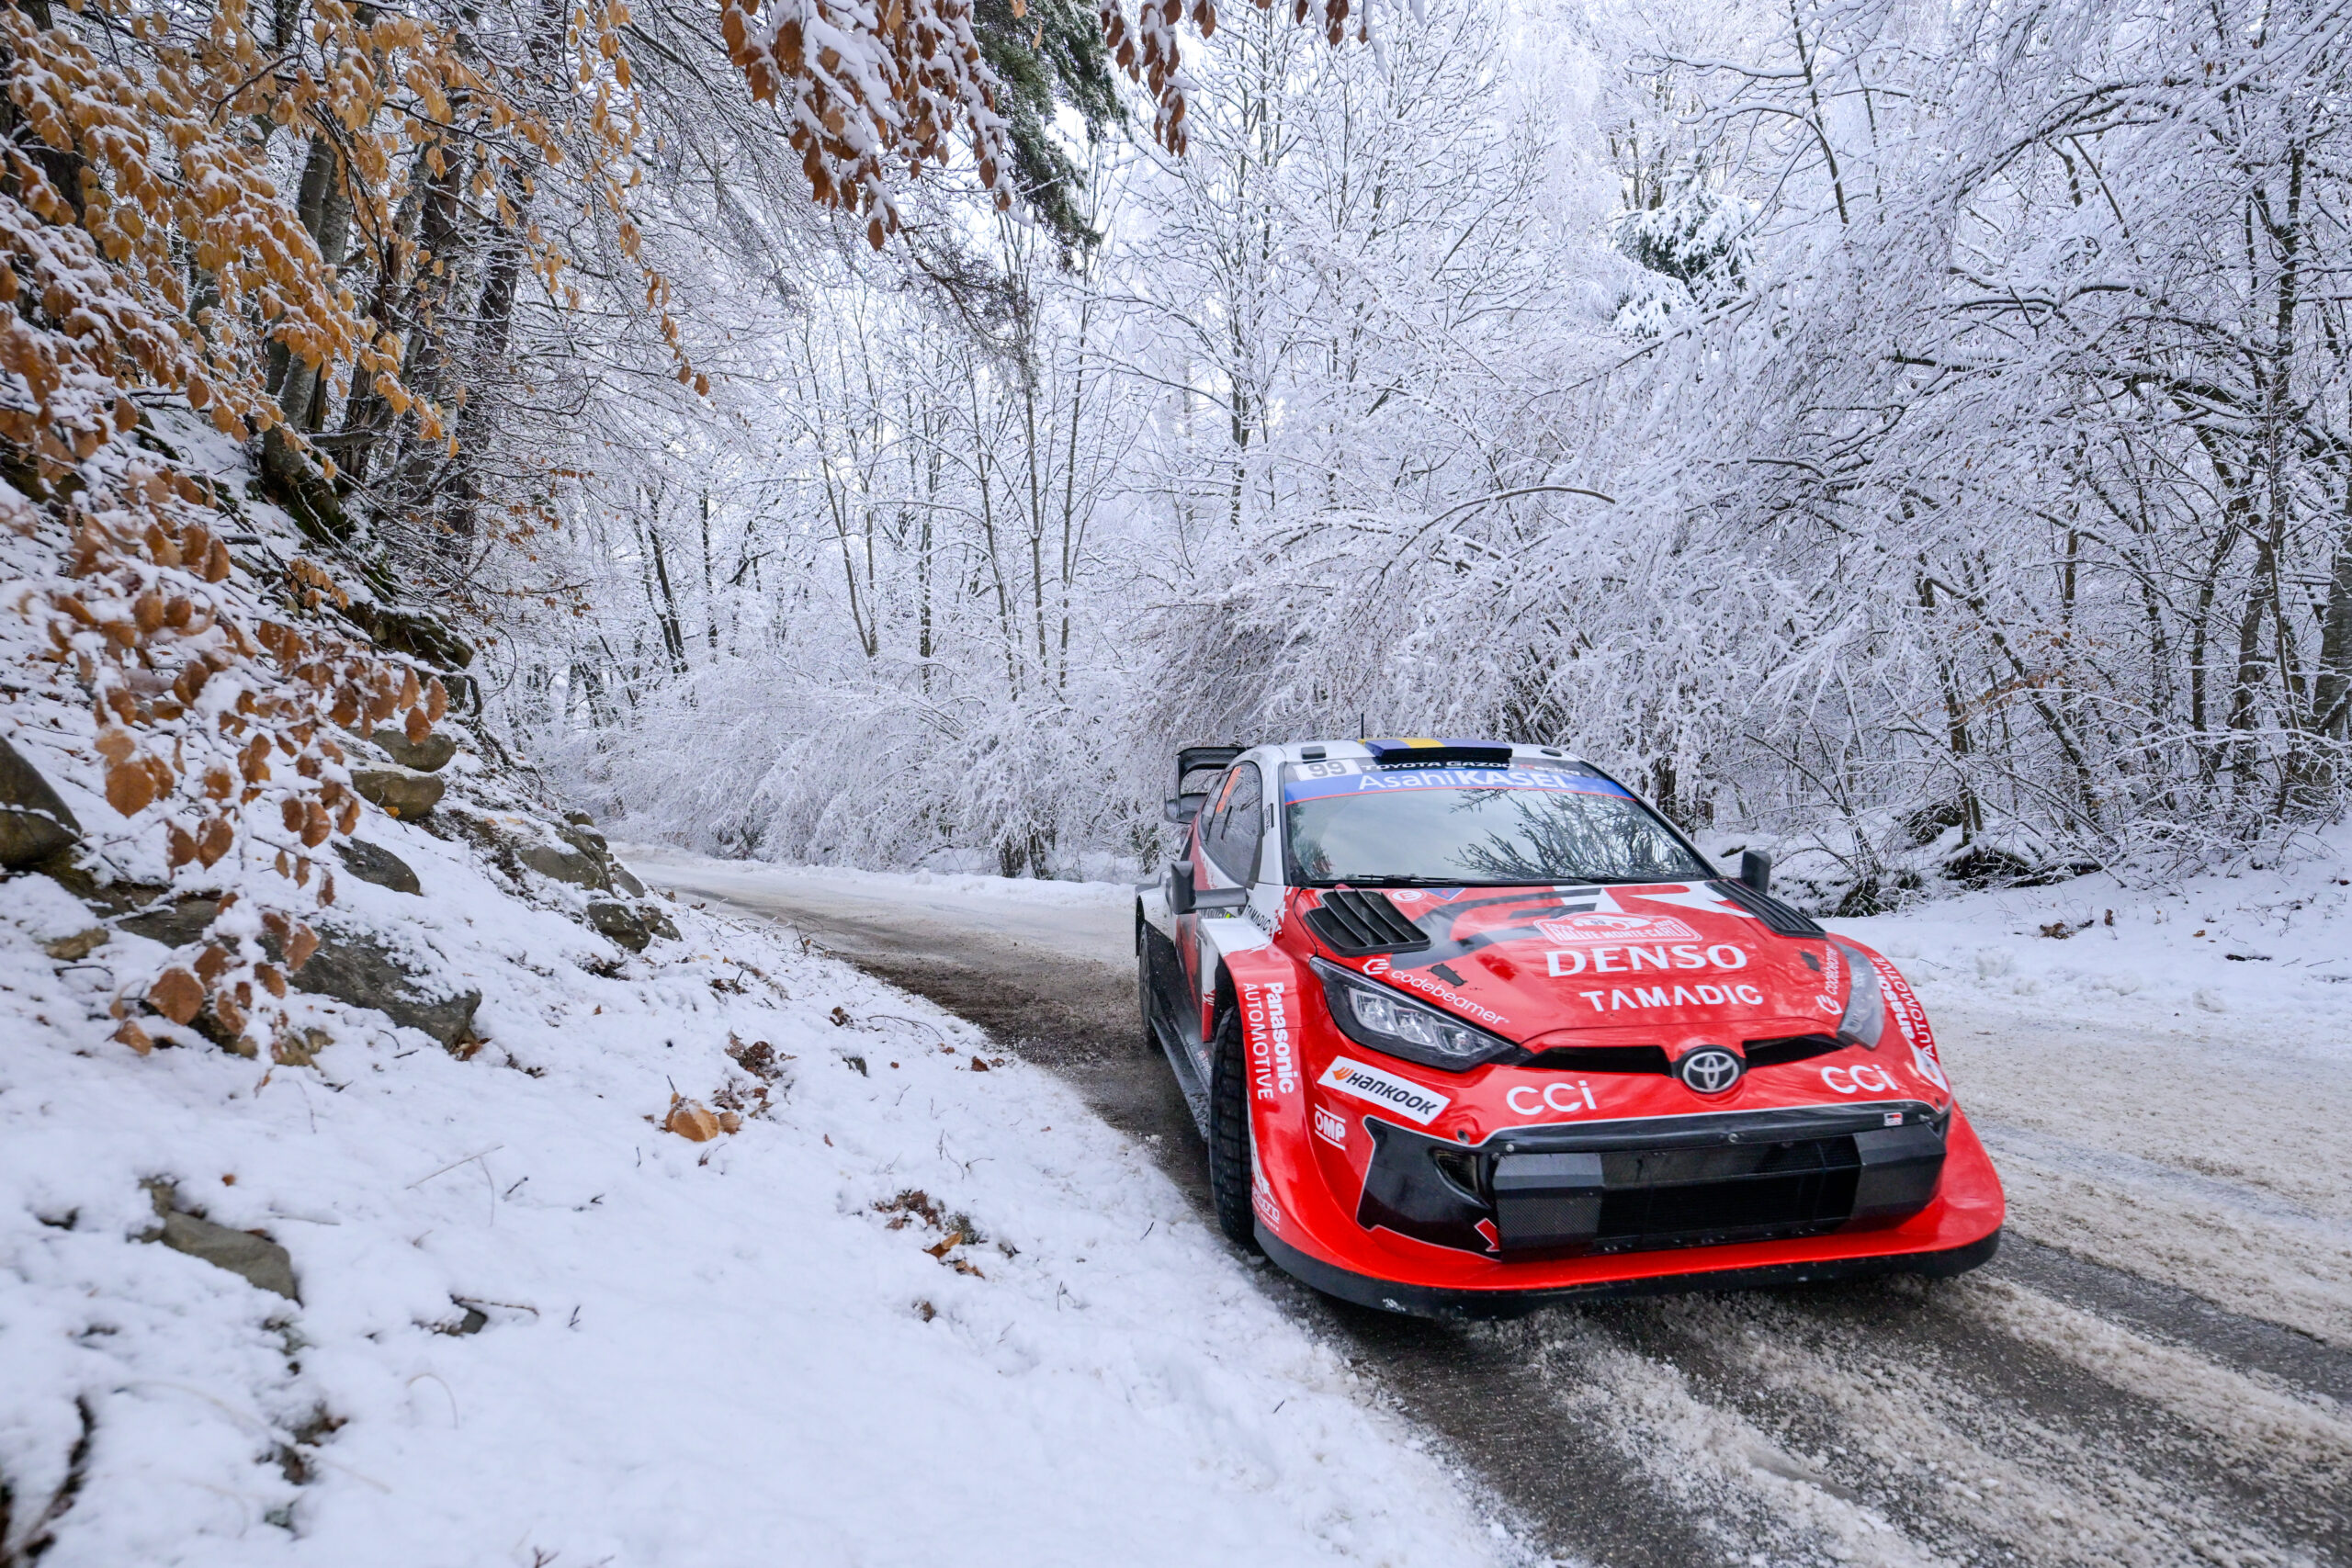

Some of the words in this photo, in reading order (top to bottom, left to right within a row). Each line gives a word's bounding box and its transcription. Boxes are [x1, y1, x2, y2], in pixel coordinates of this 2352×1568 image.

[1308, 761, 1347, 778] 99
[1361, 761, 1441, 771] TOYOTA
[1446, 761, 1515, 769] GAZOO
[1245, 905, 1272, 931] TAMADIC
[1550, 927, 1601, 942] RALLYE
[1545, 944, 1747, 977] DENSO
[1391, 969, 1507, 1026] codebeamer
[1579, 984, 1763, 1011] TAMADIC
[1873, 957, 1936, 1057] AUTOMOTIVE
[1242, 983, 1273, 1100] AUTOMOTIVE
[1264, 982, 1299, 1094] Panasonic
[1315, 1111, 1346, 1142] OMP
